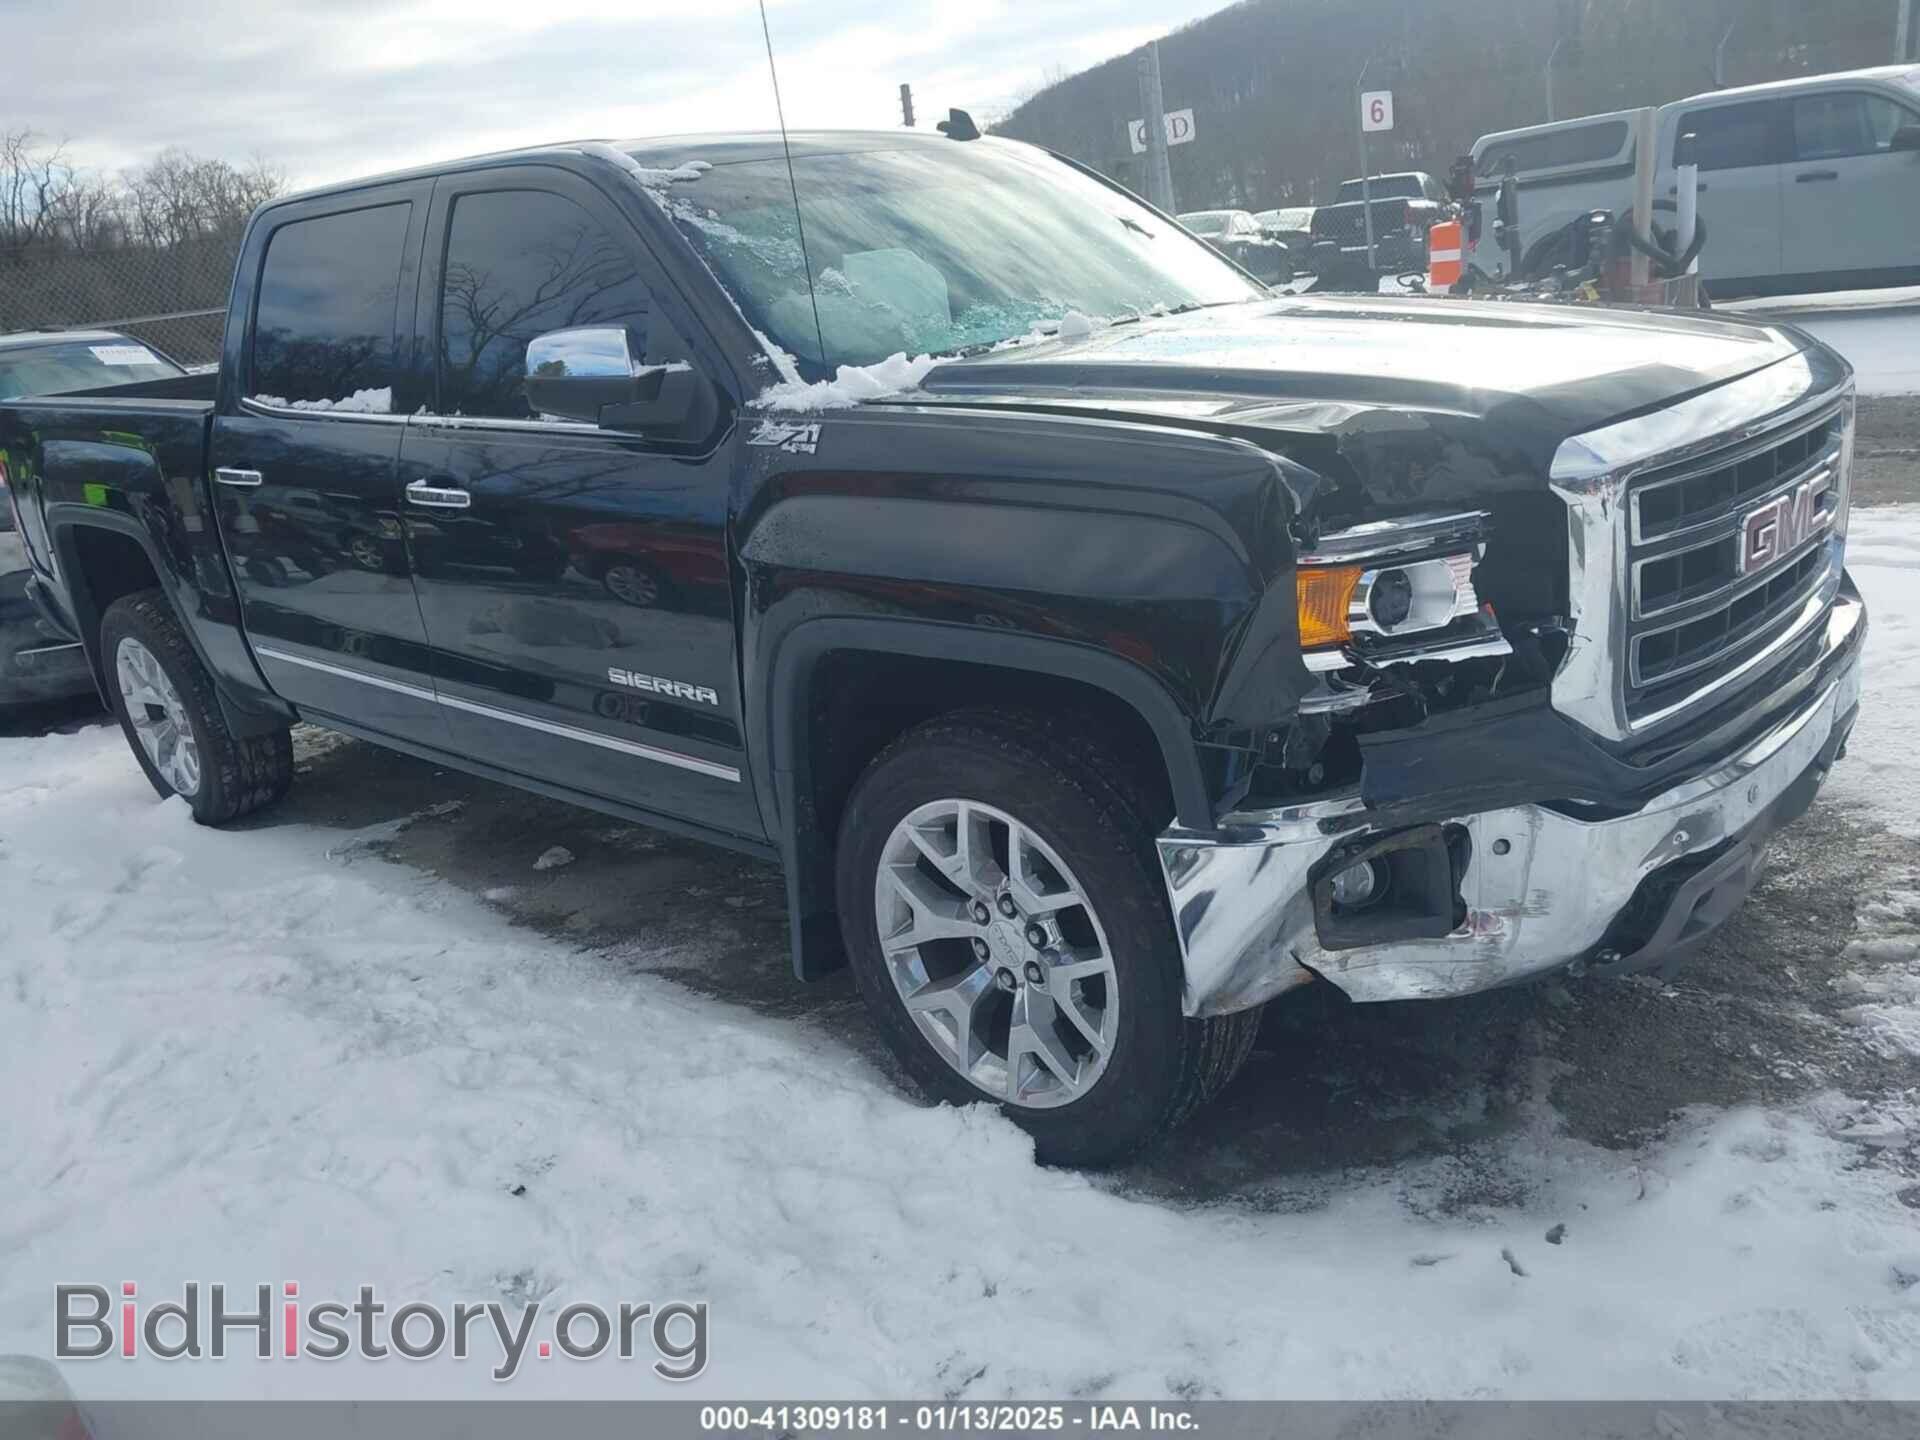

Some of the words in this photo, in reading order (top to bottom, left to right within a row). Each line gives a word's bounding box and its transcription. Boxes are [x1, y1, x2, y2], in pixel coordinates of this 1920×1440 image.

[1371, 99, 1384, 123] 6
[1171, 117, 1188, 138] D
[1741, 469, 1838, 573] GMC
[608, 667, 719, 705] SIERRA
